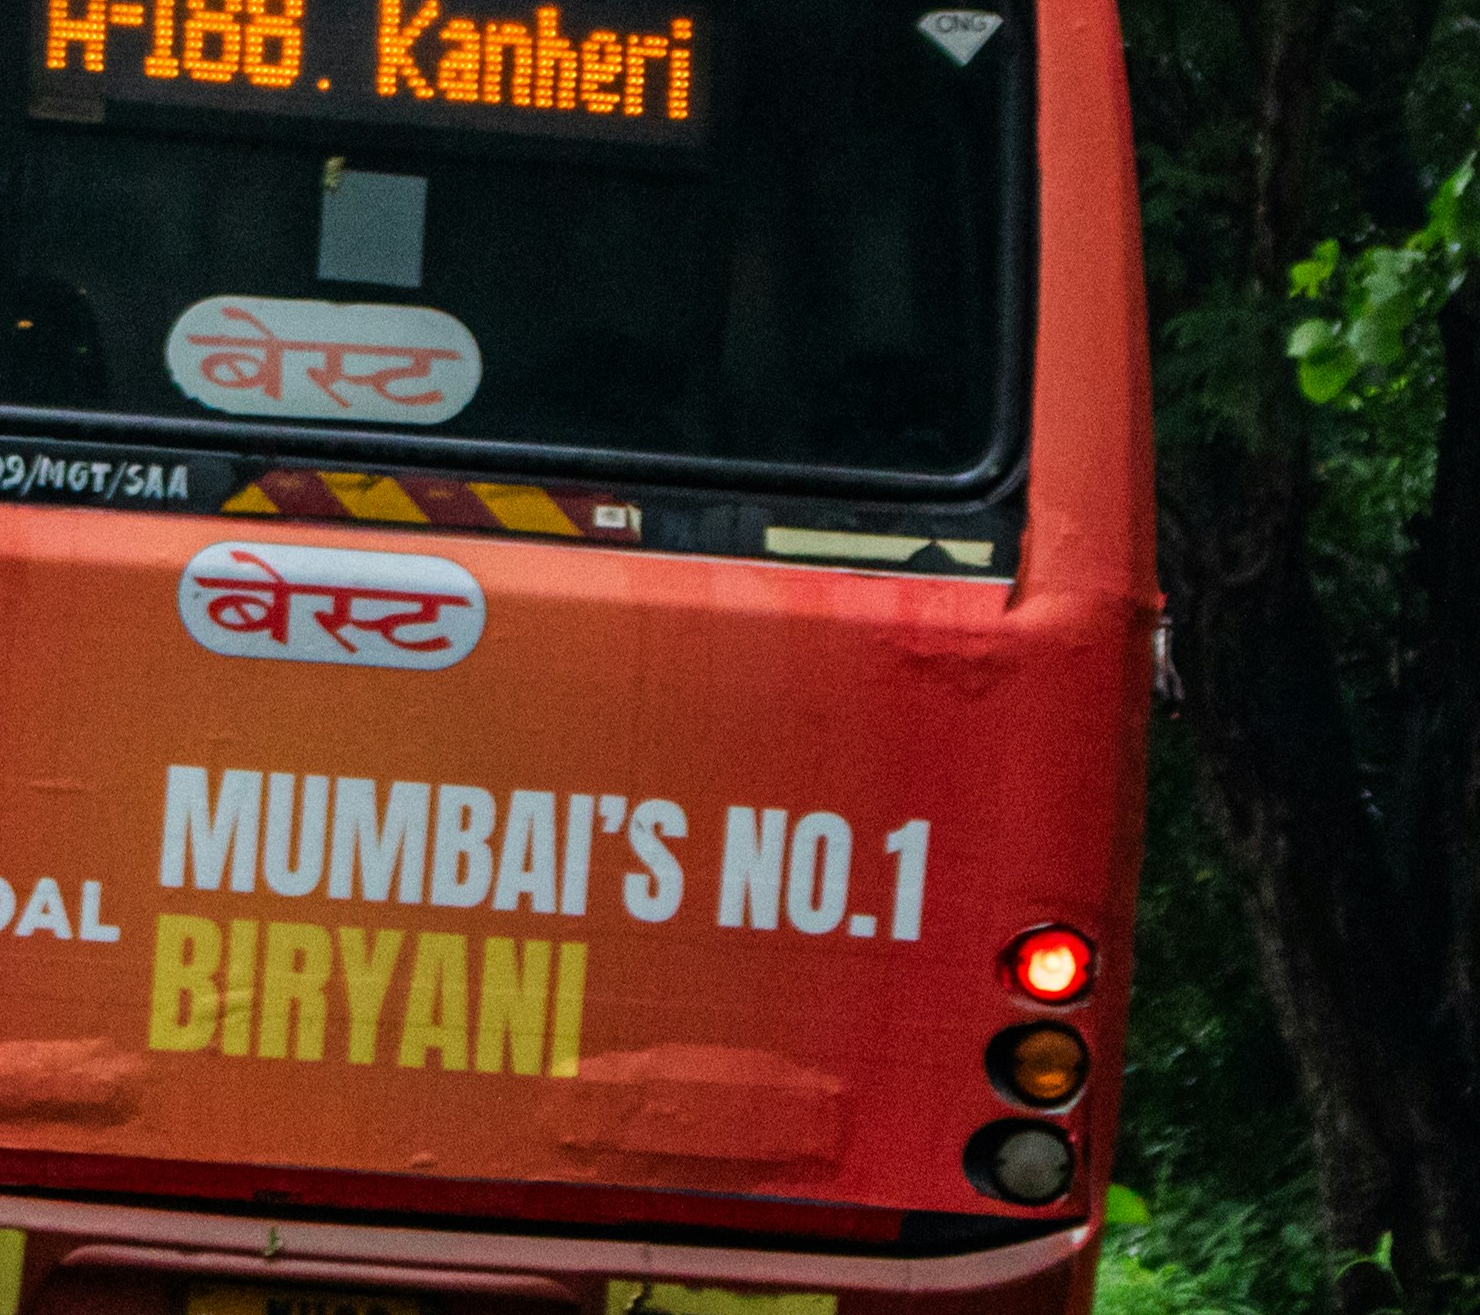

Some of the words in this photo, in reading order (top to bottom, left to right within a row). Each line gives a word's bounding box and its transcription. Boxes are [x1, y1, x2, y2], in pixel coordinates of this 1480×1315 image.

[936, 13, 988, 34] CNG
[186, 306, 462, 408] बेस्ट
[193, 550, 472, 654] बेस्ट
[159, 764, 689, 923] MUMBAI'S
[717, 805, 931, 942] NO.1
[148, 913, 588, 1078] BIRYANI
